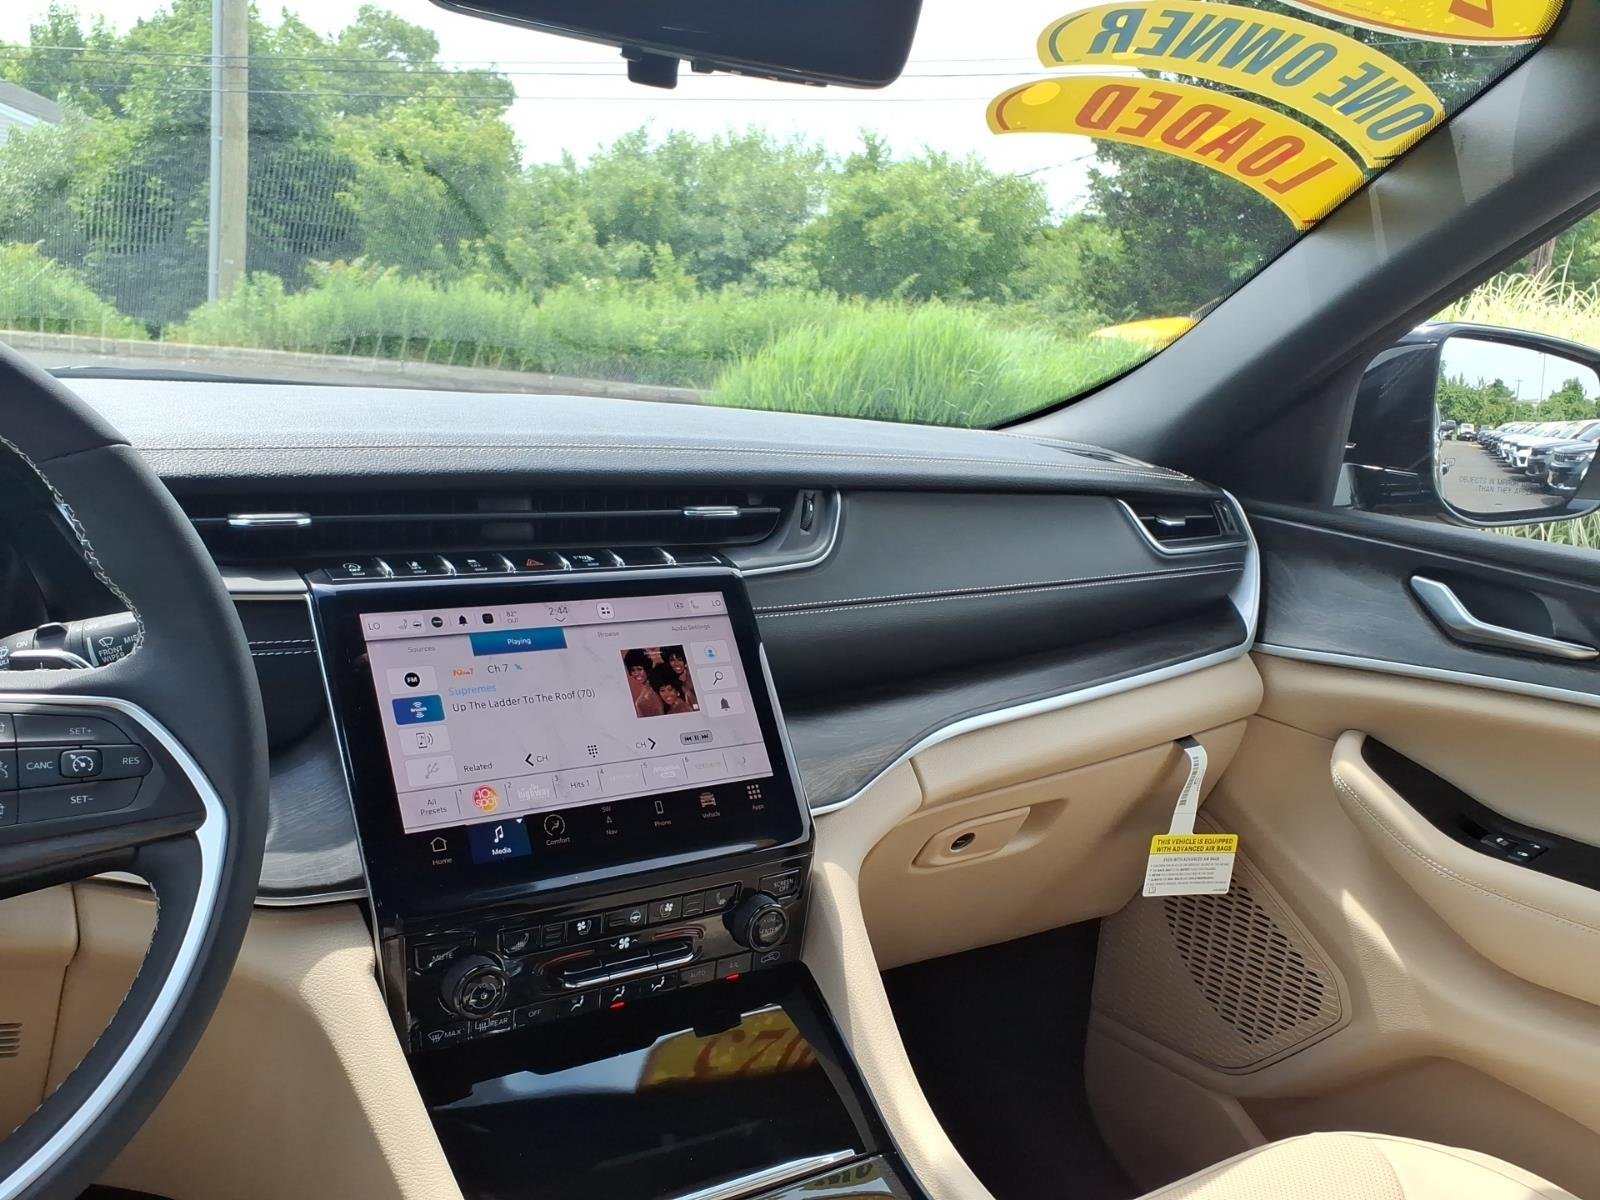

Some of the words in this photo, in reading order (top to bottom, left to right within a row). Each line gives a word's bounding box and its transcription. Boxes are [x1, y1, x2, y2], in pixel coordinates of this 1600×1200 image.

[549, 606, 569, 615] 2:44
[16, 640, 28, 649] ON
[507, 637, 532, 646] Playing
[98, 645, 123, 657] FRONT
[407, 645, 436, 653] Sources
[487, 665, 500, 674] Ch
[502, 663, 509, 673] 7
[448, 683, 497, 697] Supremes
[452, 703, 467, 713] Up
[469, 700, 487, 710] The
[489, 697, 521, 709] Ladder
[523, 695, 535, 704] To
[536, 693, 553, 703] The
[555, 689, 576, 700] Roof
[577, 687, 596, 700] (70)
[636, 741, 647, 749] CH
[122, 757, 140, 765] RES
[536, 755, 548, 763] CH
[26, 761, 54, 770] CANC
[464, 762, 493, 772] Related
[420, 806, 447, 816] Presets
[654, 819, 672, 828] Phone
[546, 837, 571, 846] Comfort
[1157, 838, 1171, 846] THIS
[492, 847, 512, 856] Media
[432, 858, 452, 866] Home
[432, 952, 454, 962] MUTE
[528, 1008, 542, 1018] OFF
[444, 1029, 461, 1039] MAX
